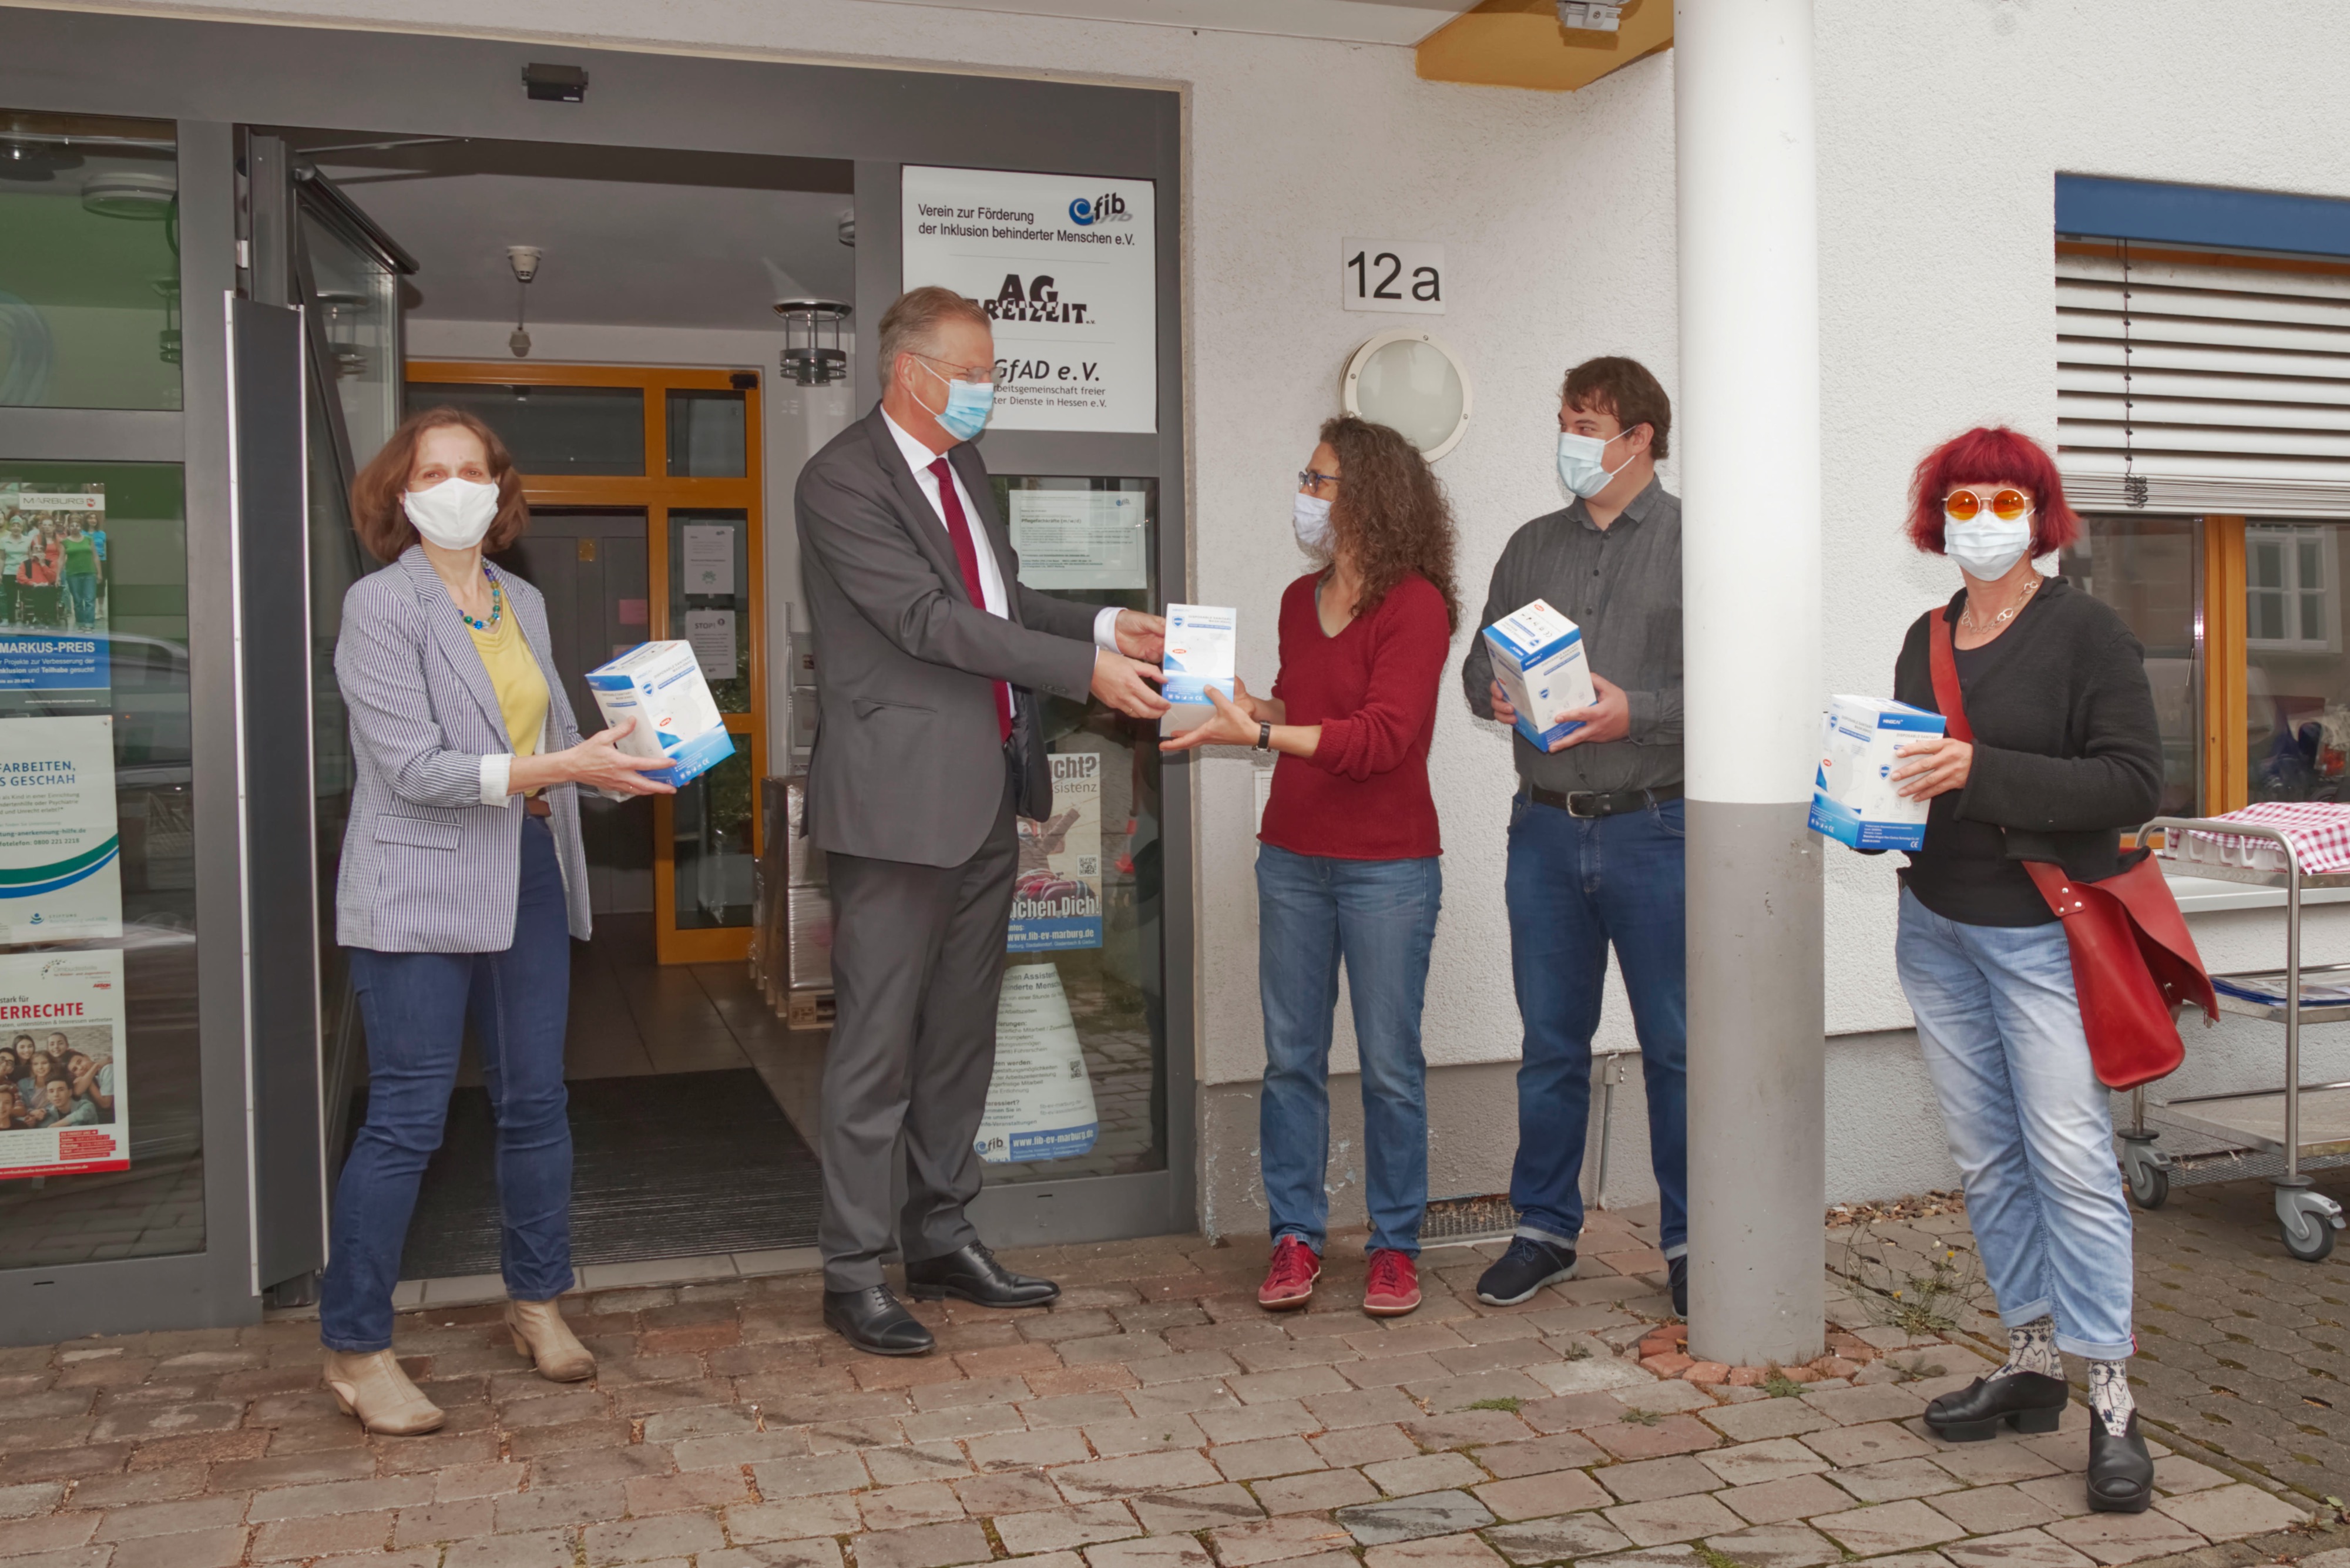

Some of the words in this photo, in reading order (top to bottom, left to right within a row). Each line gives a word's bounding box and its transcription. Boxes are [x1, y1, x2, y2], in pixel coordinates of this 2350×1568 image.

[918, 203, 954, 217] Verein
[957, 209, 975, 218] zur
[978, 207, 1034, 225] Förderung
[1094, 192, 1125, 221] fib
[918, 222, 937, 234] der
[941, 223, 989, 237] Inklusion
[992, 226, 1054, 241] behinderter
[1058, 230, 1112, 244] Menschen
[1115, 233, 1134, 246] e.V.
[1348, 251, 1441, 301] 12a
[997, 274, 1058, 308] AG
[1081, 386, 1105, 395] freier
[1010, 397, 1043, 405] Dienste
[1058, 398, 1087, 407] Hessen
[4, 658, 29, 666] Projekte
[11, 774, 75, 786] GESCHAH
[1061, 895, 1099, 916] Dich!
[1008, 928, 1094, 941] www.fib-ev-marburg.de
[0, 1002, 83, 1020] ERRECHTE
[988, 1137, 1003, 1151] fib
[1013, 1129, 1094, 1147] www.fib-ev-marburg.de
